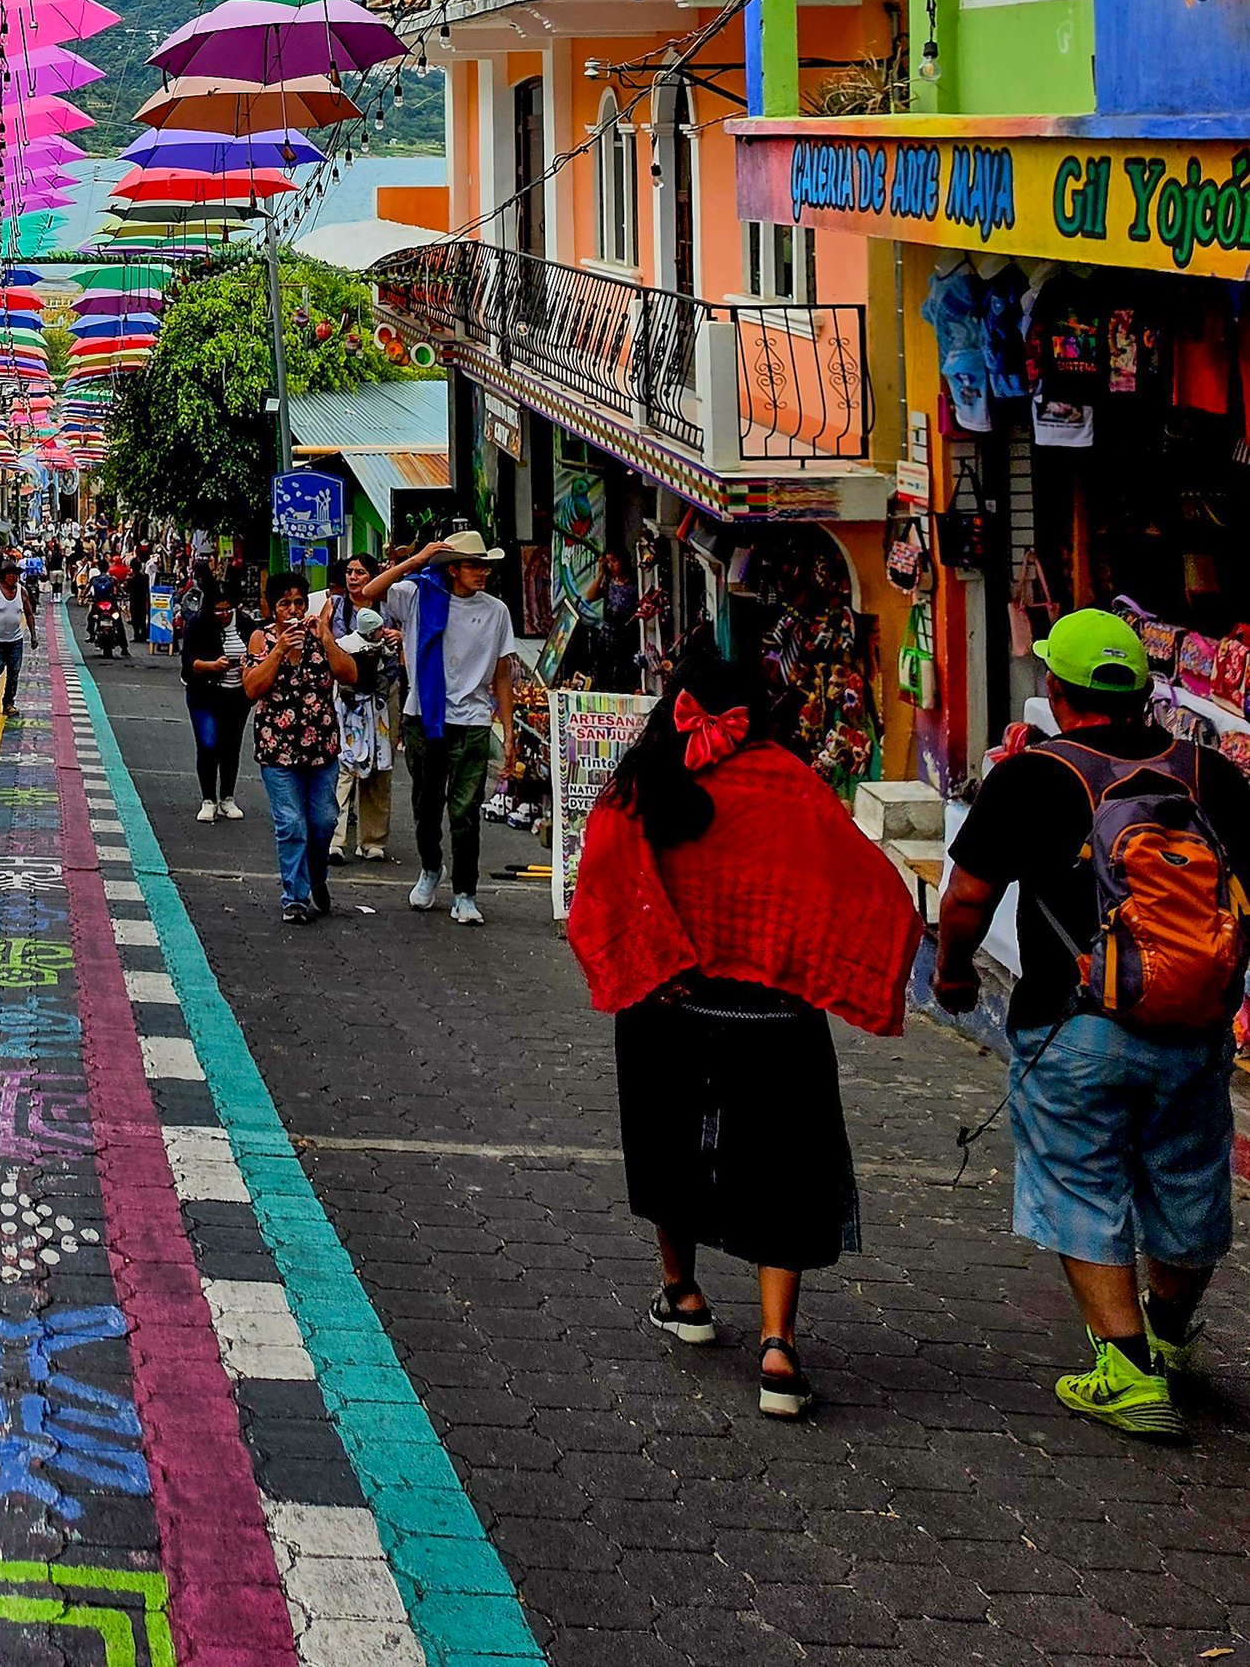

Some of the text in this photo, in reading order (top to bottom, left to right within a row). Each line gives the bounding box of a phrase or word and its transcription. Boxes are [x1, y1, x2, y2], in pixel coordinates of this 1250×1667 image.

[791, 141, 854, 223] GALERIA
[856, 142, 887, 215] DE
[890, 142, 940, 221] ARTE
[945, 144, 1015, 243] MAYA
[1053, 155, 1111, 240] Gil
[576, 728, 608, 740] SAN
